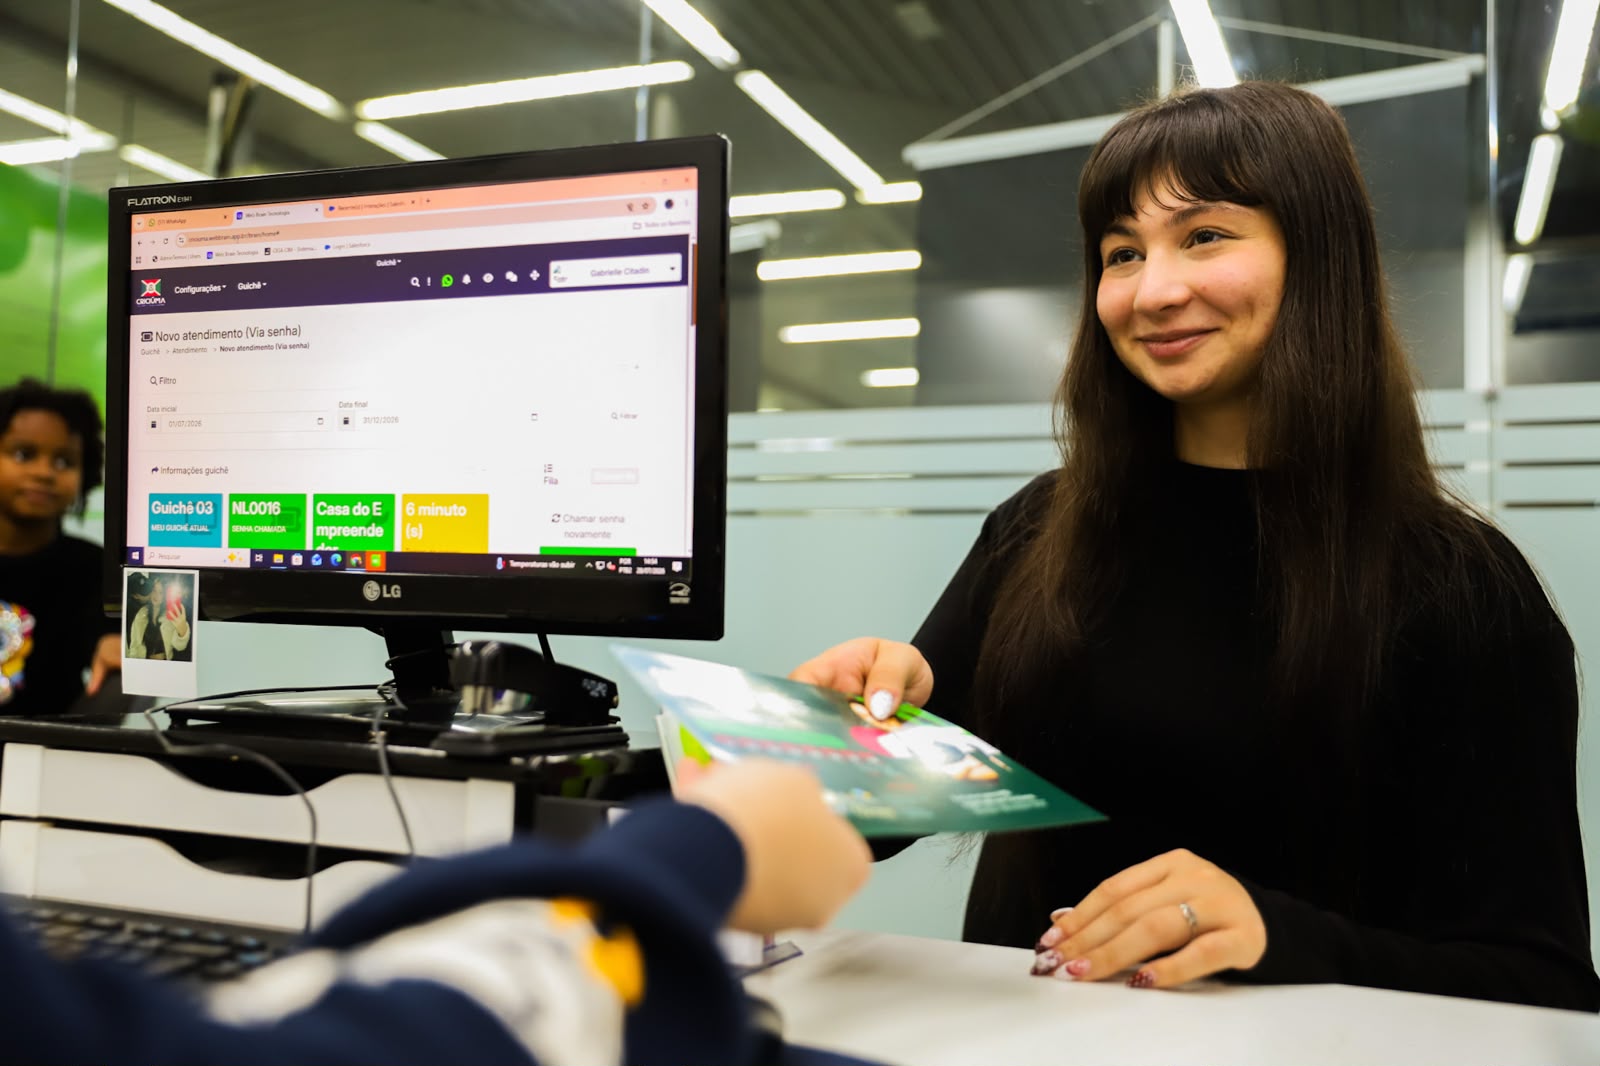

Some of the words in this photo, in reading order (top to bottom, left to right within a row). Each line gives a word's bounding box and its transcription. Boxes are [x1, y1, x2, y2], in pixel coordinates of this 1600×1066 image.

[127, 195, 177, 207] FLATRON
[166, 217, 187, 225] WhatsApp
[376, 258, 397, 267] Guichê
[590, 268, 622, 277] Gabrielle
[624, 267, 649, 276] Citadin
[174, 284, 222, 295] Configurações
[238, 281, 262, 290] Guichê
[155, 331, 181, 342] Novo
[182, 329, 243, 341] atendimento
[245, 326, 265, 339] (Via
[267, 324, 302, 337] senha)
[141, 347, 160, 355] Guichê
[172, 346, 208, 354] Atendimento
[219, 345, 236, 353] Novo
[236, 344, 274, 352] atendimento
[275, 342, 288, 351] (Via
[288, 342, 310, 350] senha)
[159, 376, 177, 385] Filtro
[161, 405, 177, 413] inicial
[338, 401, 353, 409] Data
[354, 400, 368, 408] final
[160, 466, 203, 476] Informações
[205, 465, 229, 477] guichê
[151, 500, 194, 515] Guichê
[195, 501, 213, 515] 03
[231, 501, 281, 515] NL0016
[316, 501, 350, 516] Casa
[352, 501, 370, 516] do
[372, 501, 382, 516] E
[405, 502, 415, 516] 6
[418, 502, 467, 517] minuto
[563, 513, 596, 524] Chamar
[599, 513, 625, 524] senha
[151, 524, 165, 532] MEU
[165, 522, 189, 532] GUICHÊ
[189, 524, 209, 532] ATUAL
[231, 525, 253, 533] SENHA
[254, 525, 286, 533] CHAMADA
[316, 523, 384, 540] mpreende
[405, 523, 423, 540] (s)
[564, 529, 612, 539] novamente
[509, 559, 549, 569] Temperaturas
[560, 560, 576, 569] subir
[382, 584, 402, 598] LG
